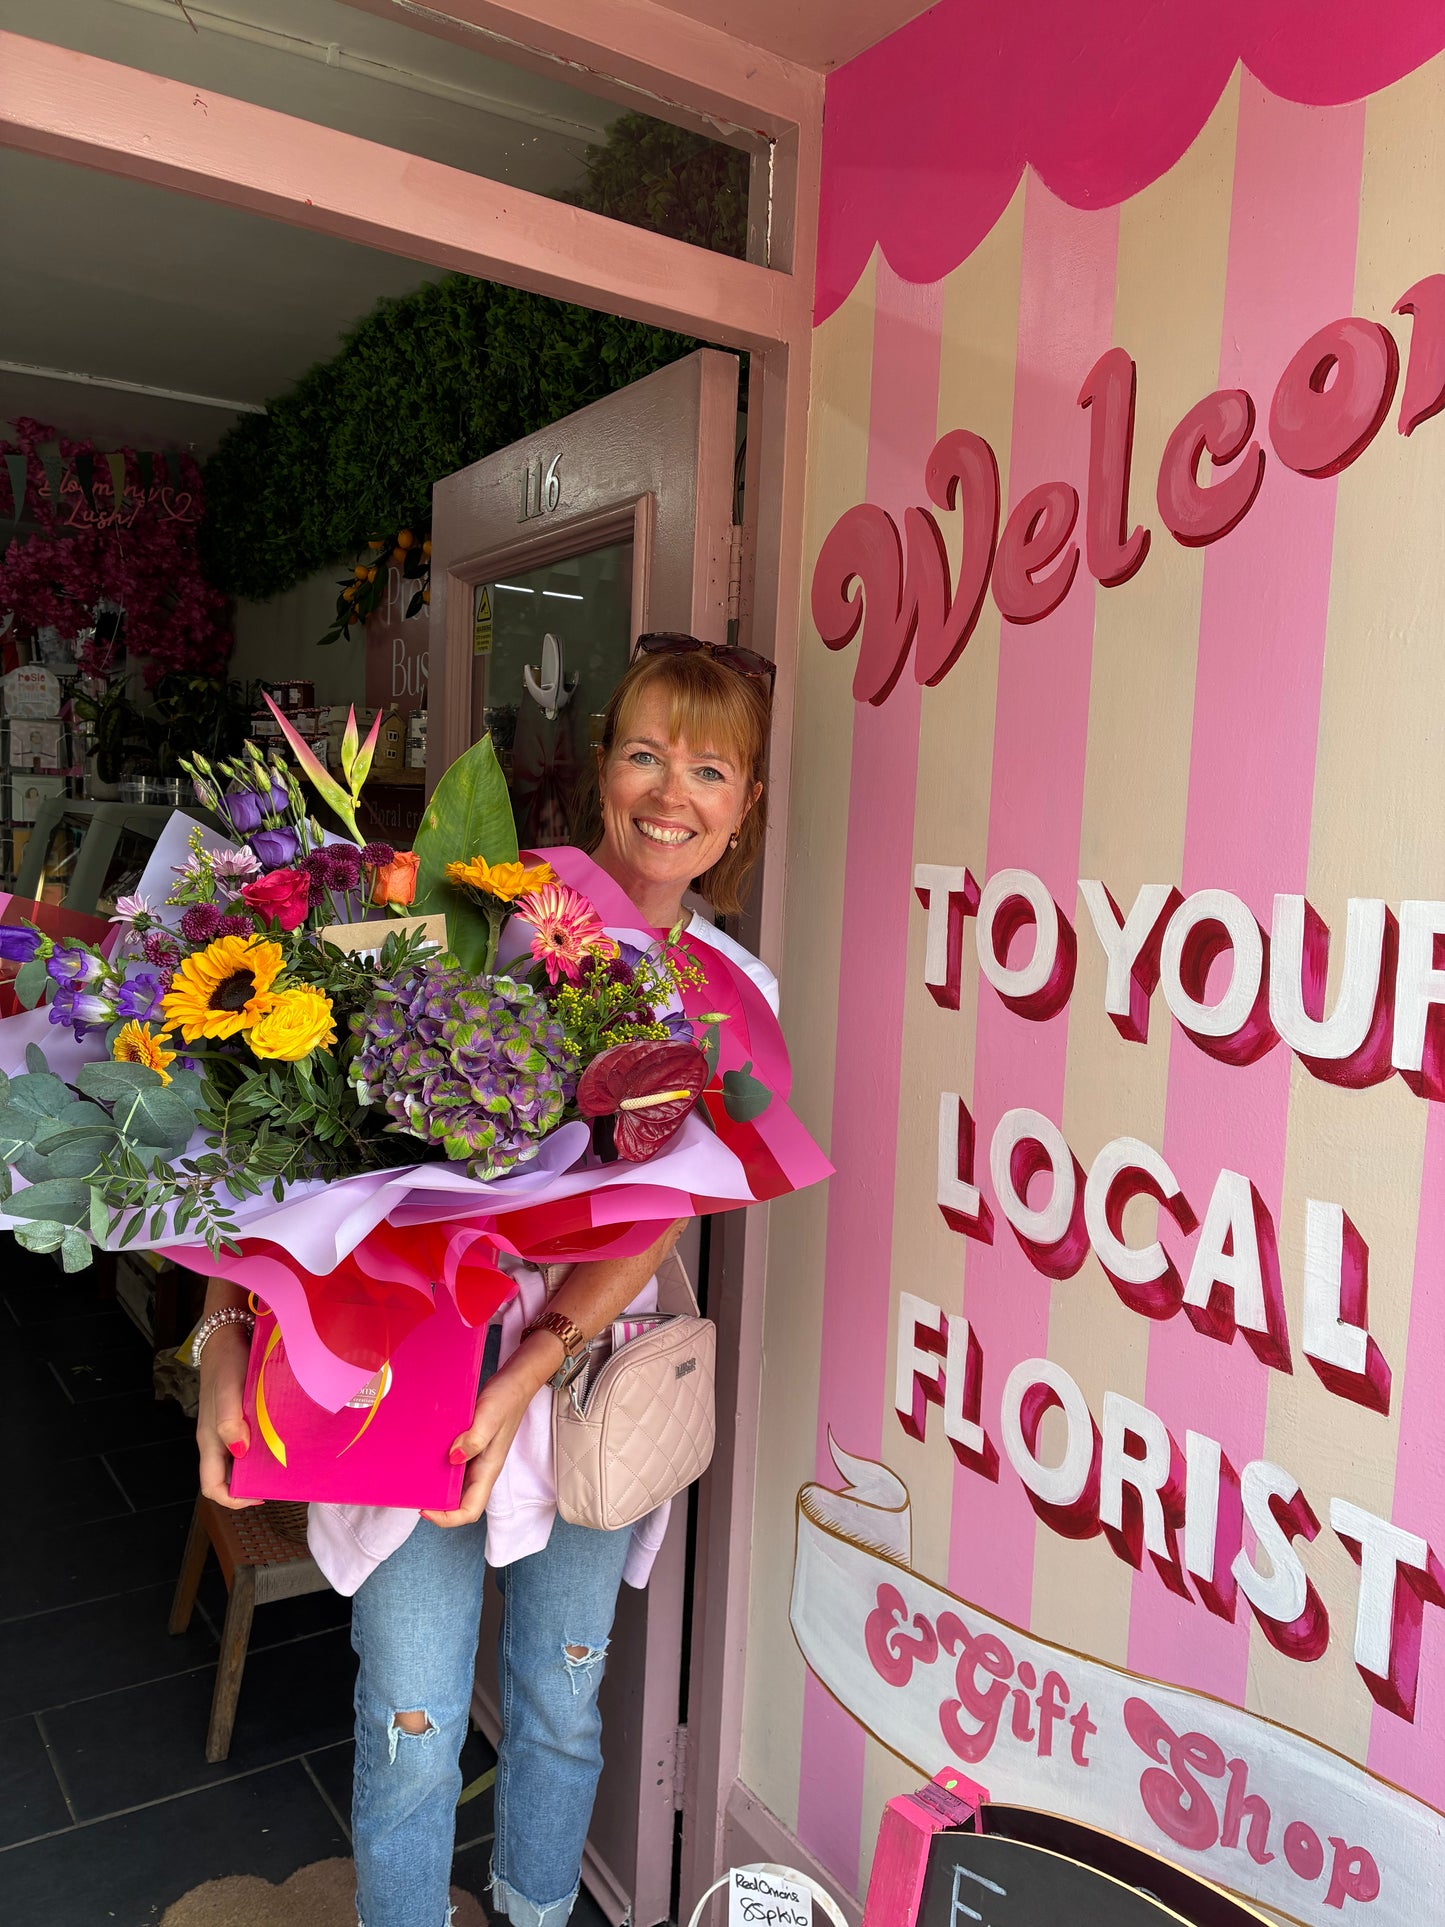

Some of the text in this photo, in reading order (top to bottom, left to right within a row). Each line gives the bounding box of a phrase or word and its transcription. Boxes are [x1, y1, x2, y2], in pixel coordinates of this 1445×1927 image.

[517, 452, 563, 523] 116
[914, 863, 1077, 1021] TO
[937, 1091, 1392, 1417] LOCAL
[895, 1290, 1445, 1724] FLORIST
[735, 1873, 760, 1892] Red
[1123, 1696, 1381, 1909] Shop
